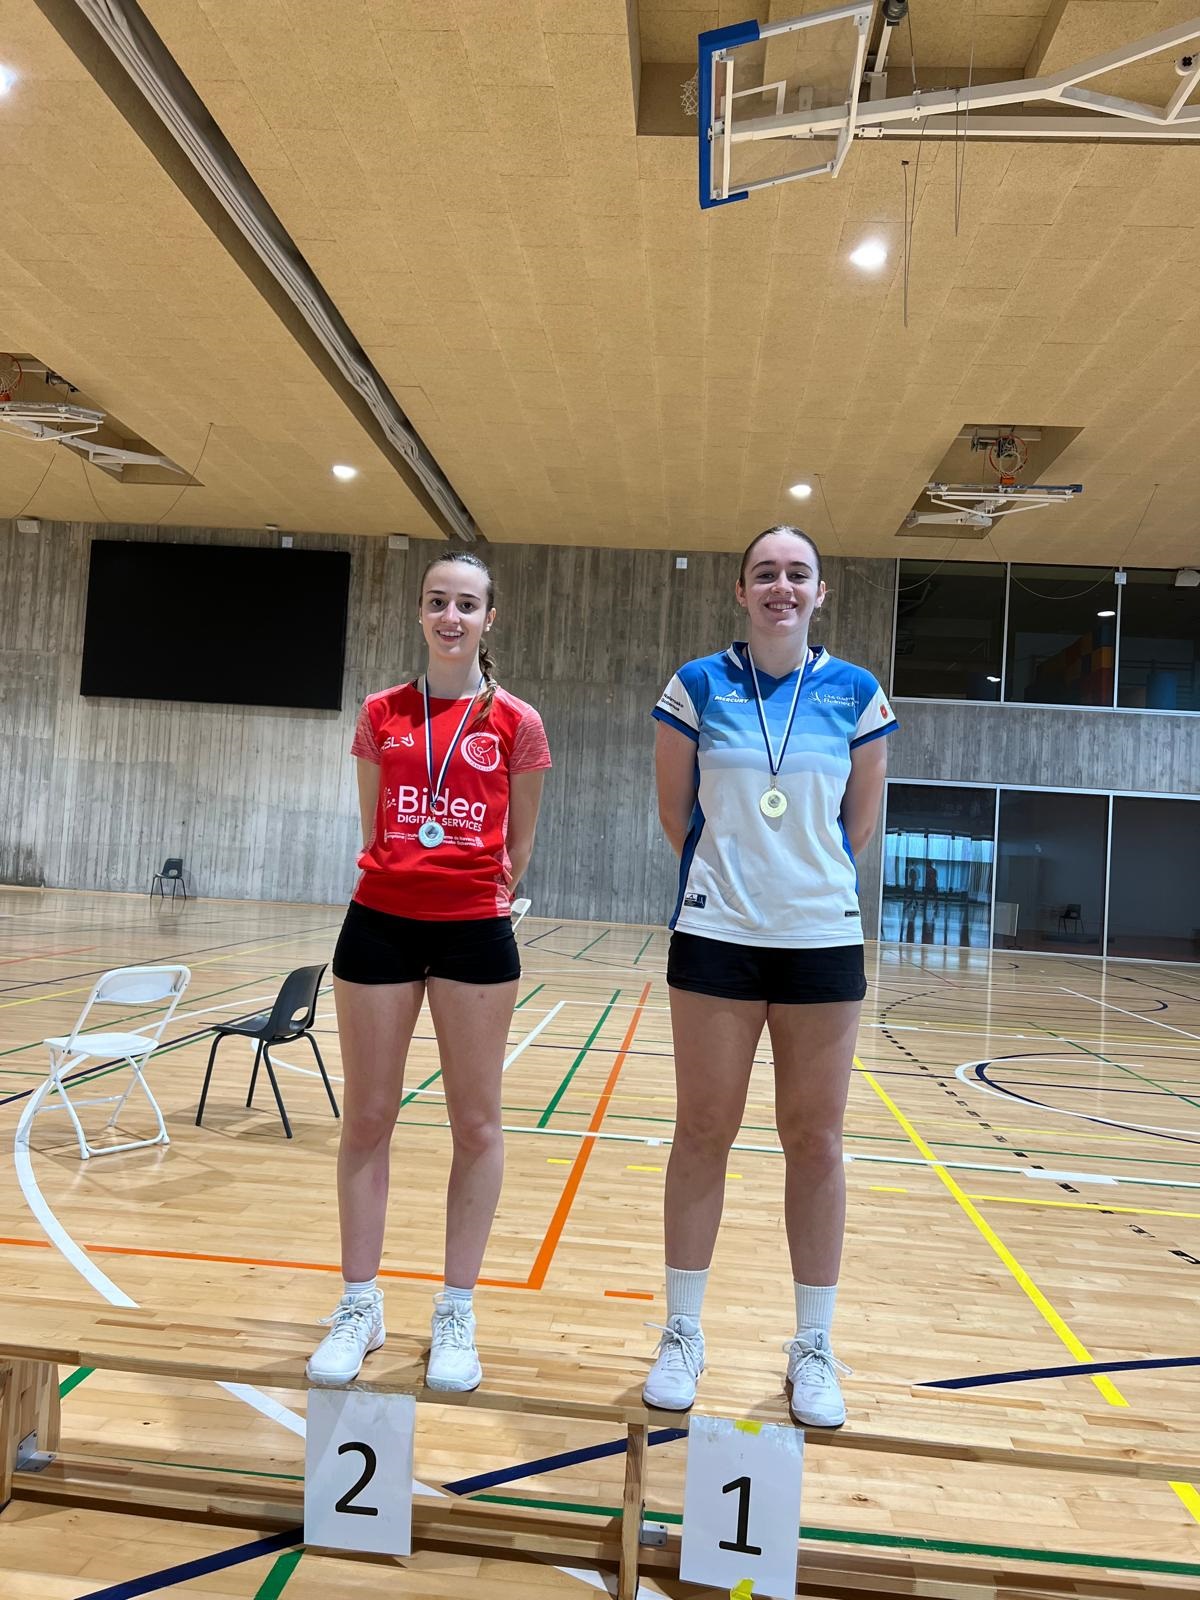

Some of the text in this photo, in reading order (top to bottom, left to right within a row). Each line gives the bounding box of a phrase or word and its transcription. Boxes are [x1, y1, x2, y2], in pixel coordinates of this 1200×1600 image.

[714, 695, 749, 704] MERCURY
[398, 785, 487, 822] Bidea
[441, 817, 483, 832] SERVICES
[334, 1441, 379, 1516] 2
[718, 1476, 762, 1556] 1
